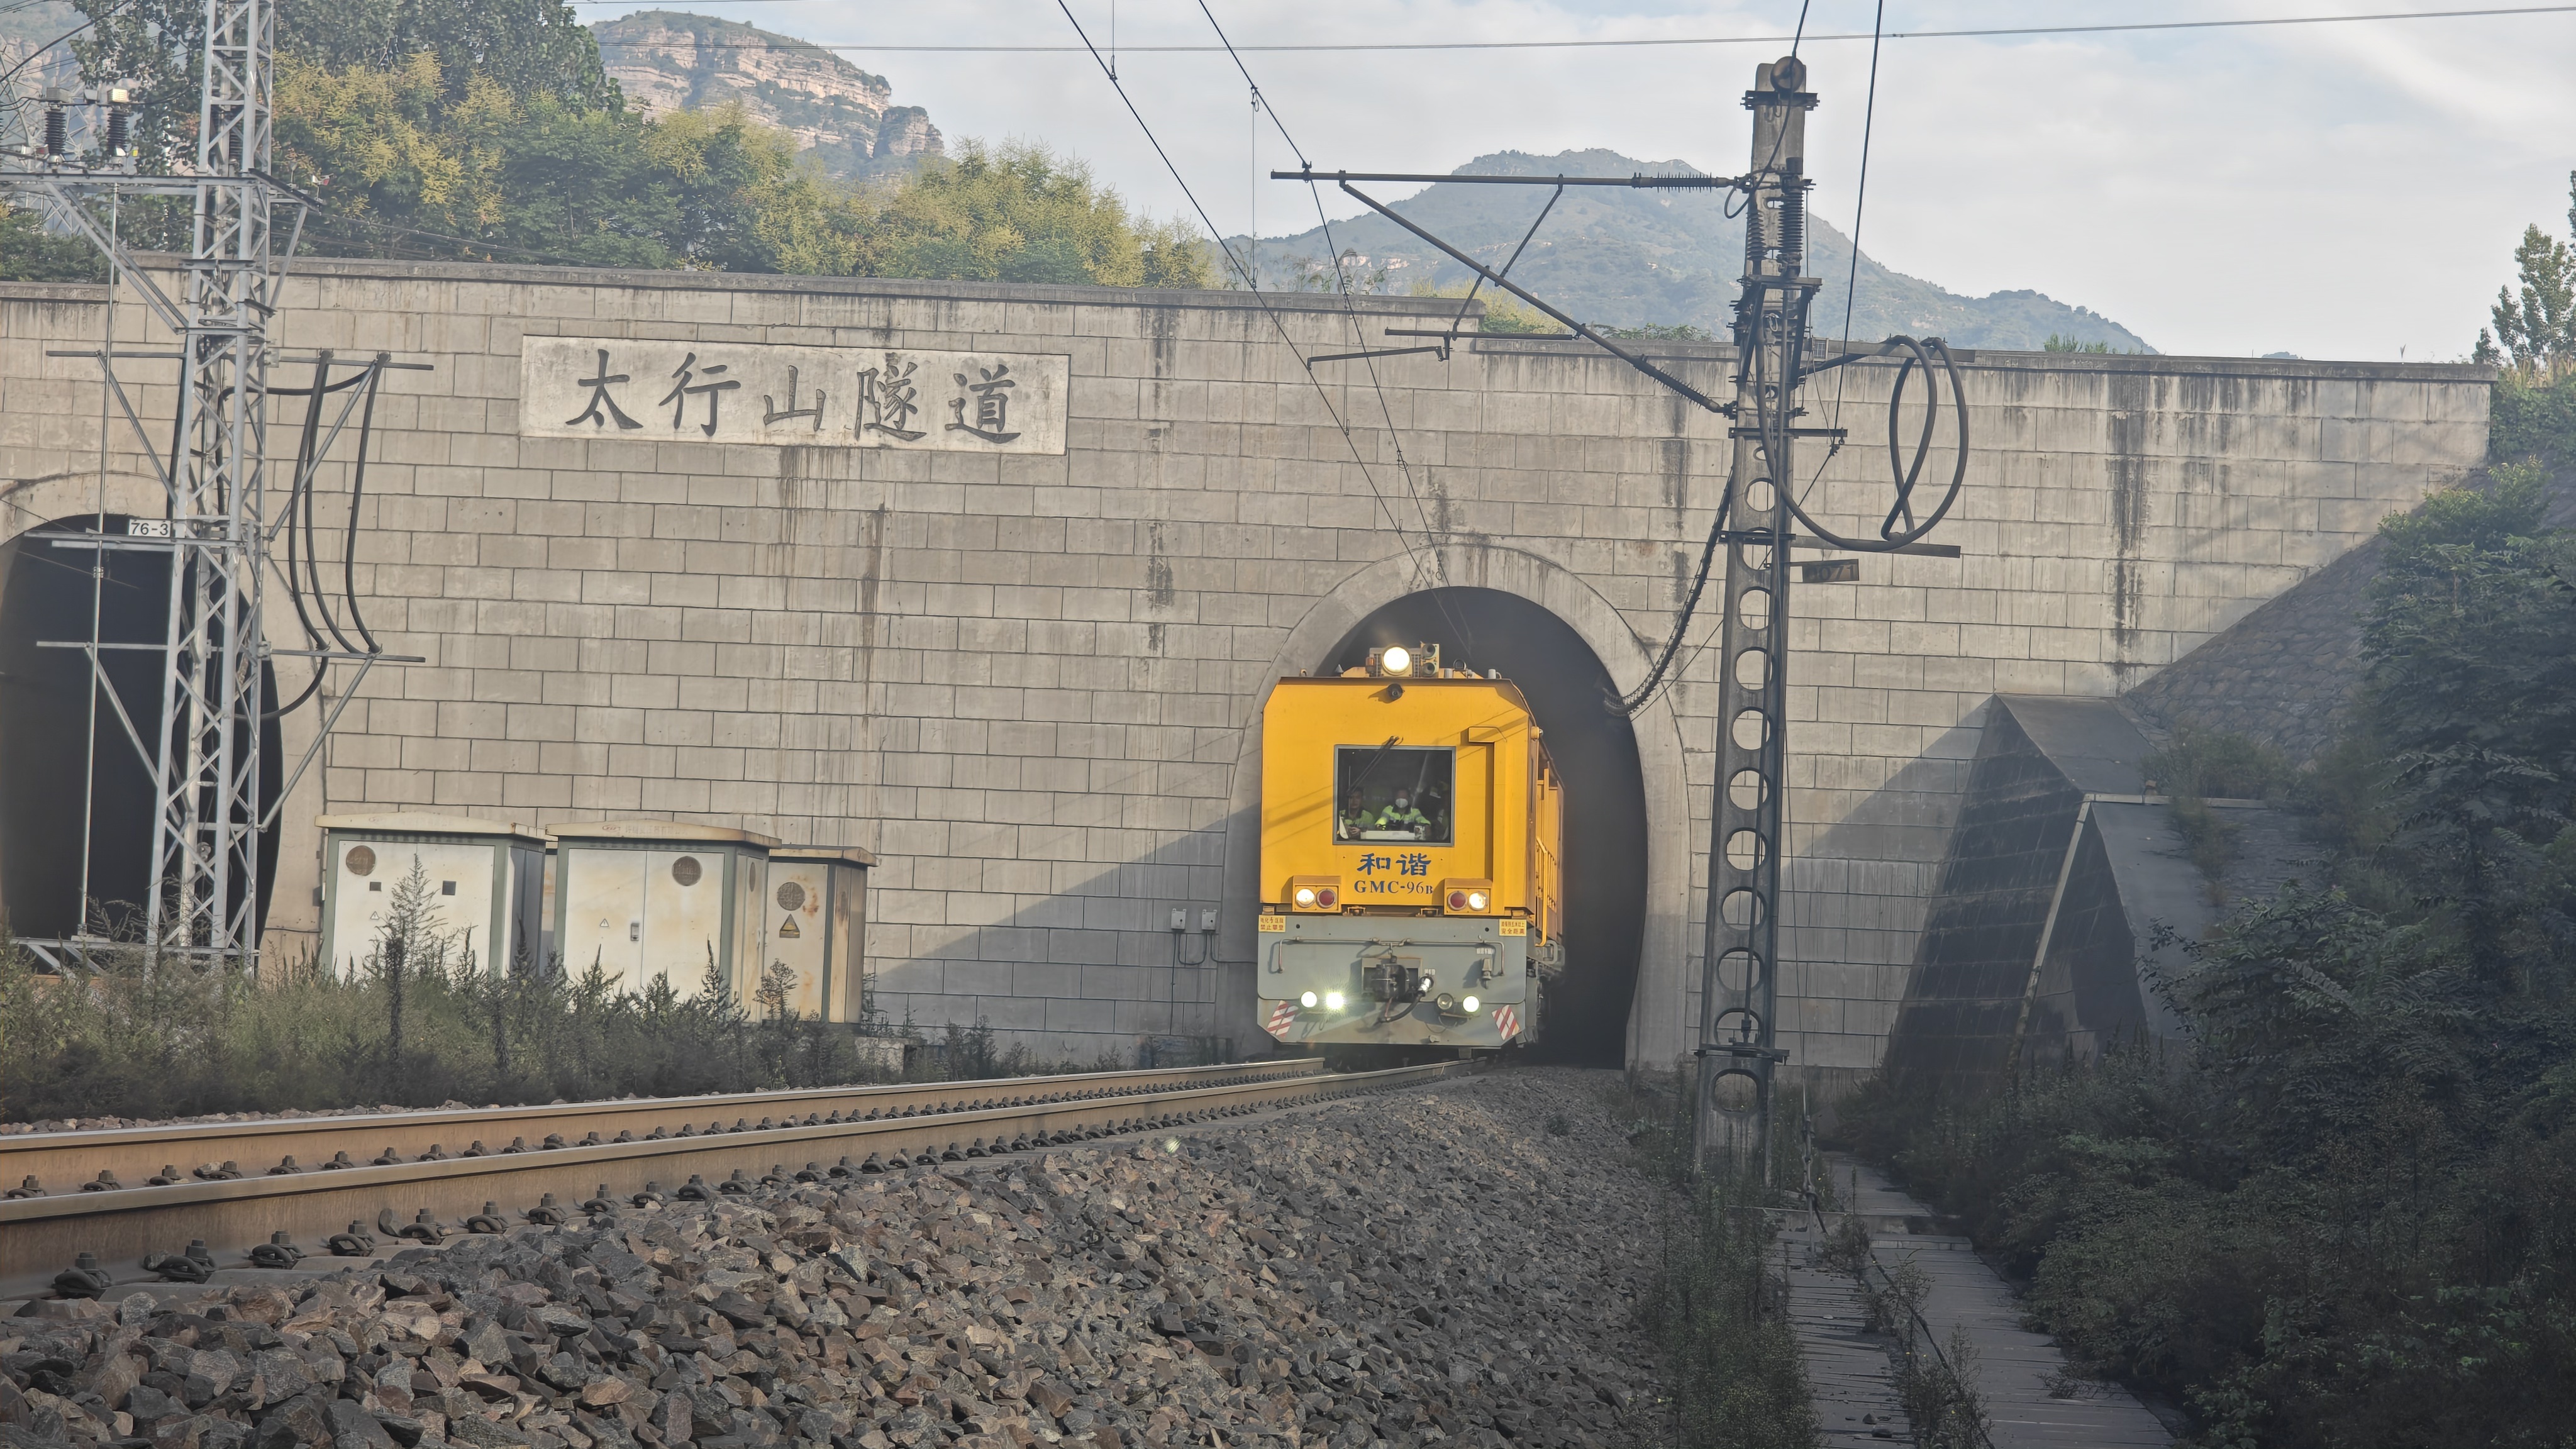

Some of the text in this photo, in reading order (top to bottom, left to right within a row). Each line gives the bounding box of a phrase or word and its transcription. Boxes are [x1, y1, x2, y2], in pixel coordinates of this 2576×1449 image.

[565, 348, 1021, 443] 太行山隧道
[130, 522, 169, 536] 76-3
[1357, 853, 1431, 876] 和谐
[1354, 880, 1433, 894] GMC-96B
